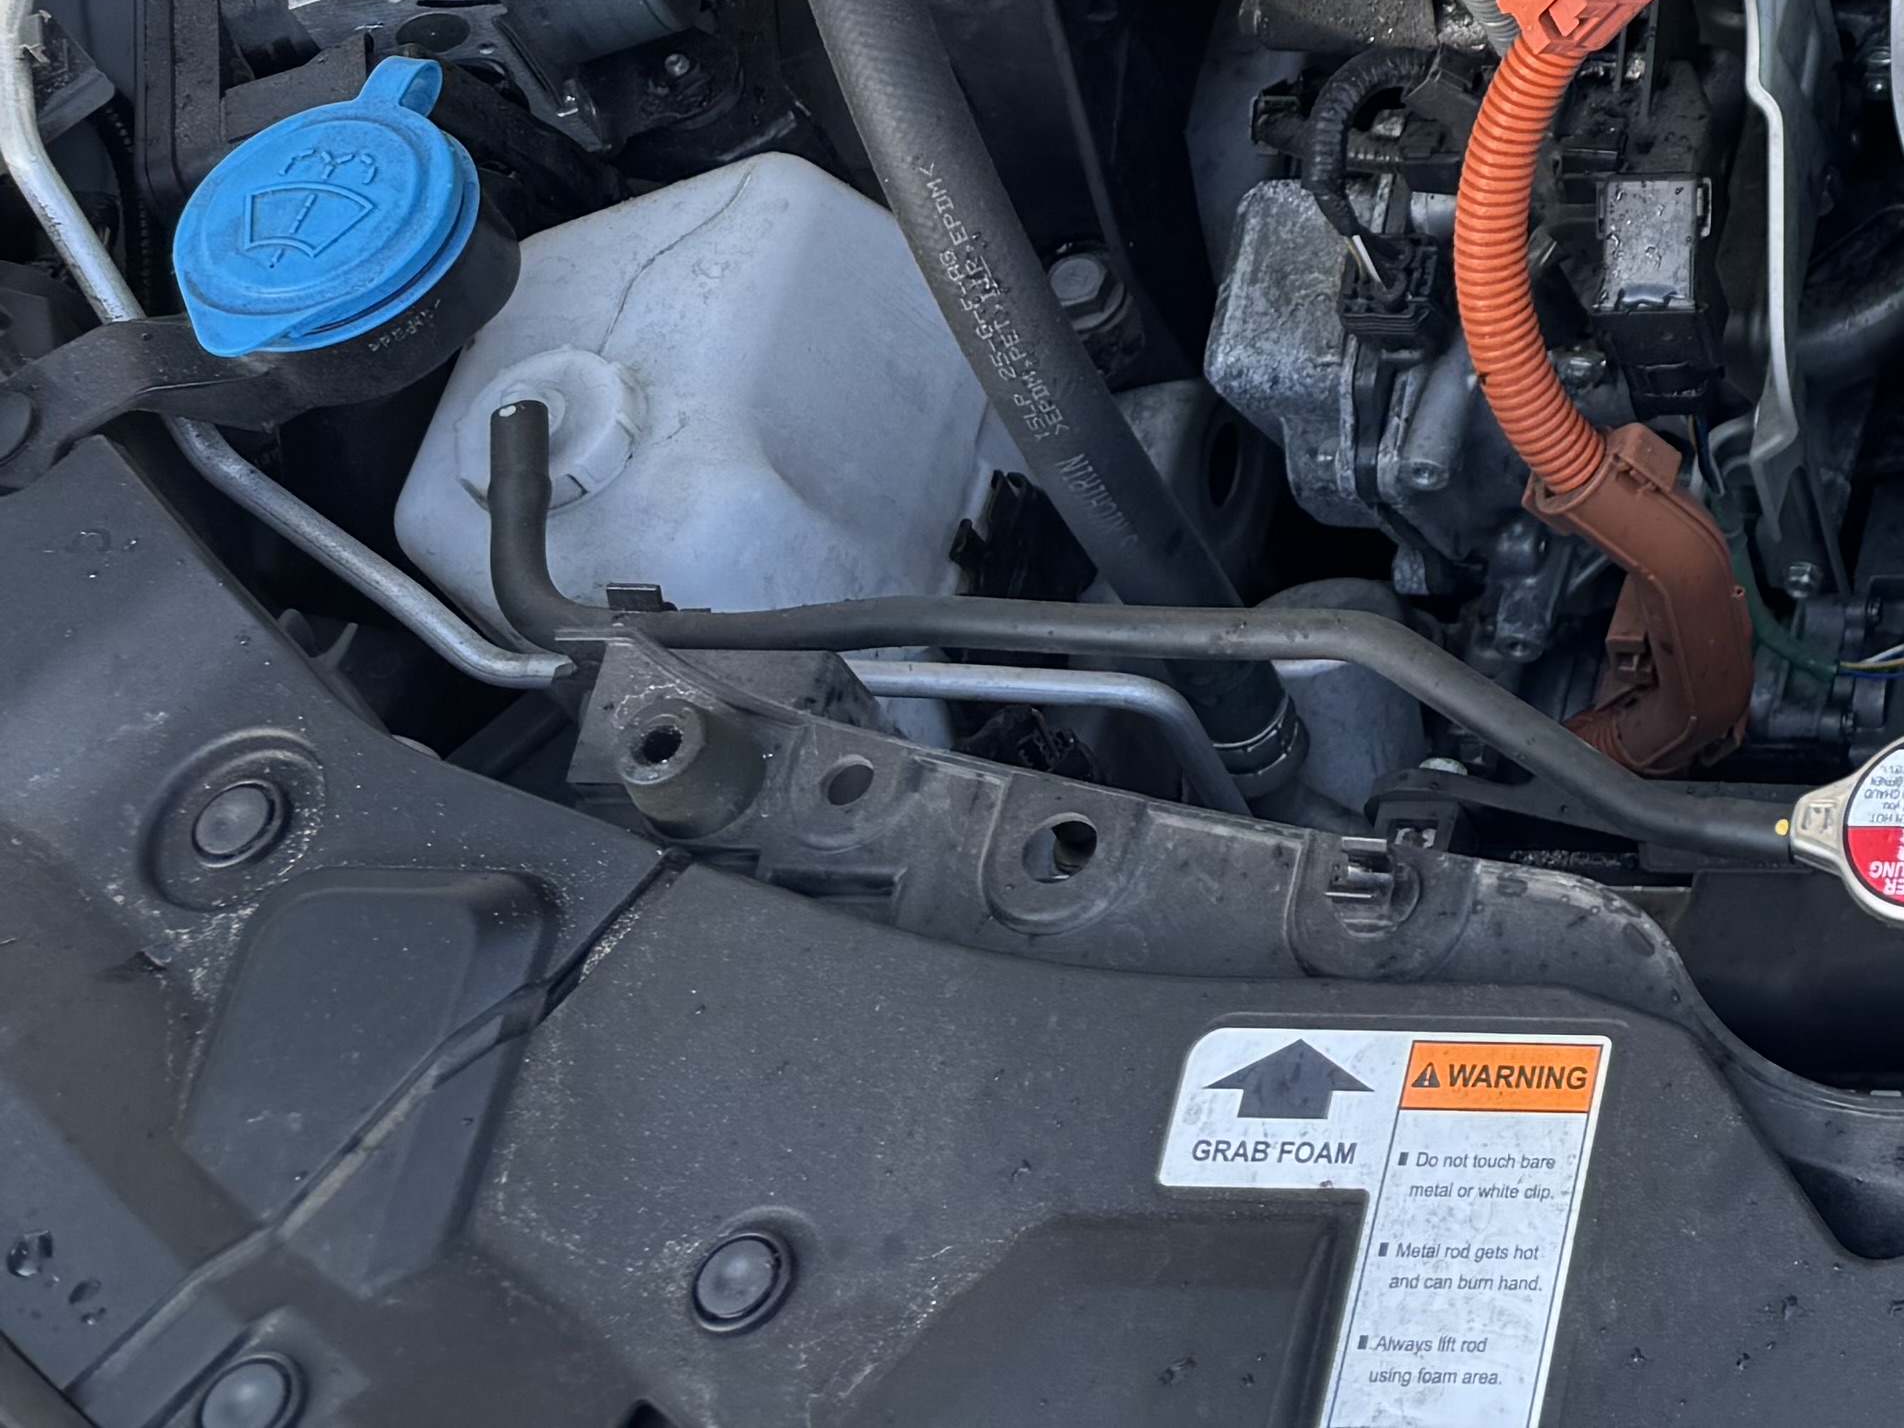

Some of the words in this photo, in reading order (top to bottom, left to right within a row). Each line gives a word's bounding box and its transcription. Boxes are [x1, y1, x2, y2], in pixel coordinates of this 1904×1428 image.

[1448, 1063, 1589, 1090] WARNING
[1192, 1139, 1271, 1162] GRAB
[1276, 1141, 1357, 1164] FOAM
[1416, 1152, 1438, 1169] Do
[1443, 1154, 1468, 1169] not
[1473, 1153, 1516, 1170] touch
[1520, 1154, 1556, 1170] bare
[1409, 1182, 1453, 1199] metal
[1457, 1186, 1473, 1199] or
[1477, 1183, 1519, 1200] white
[1524, 1184, 1555, 1203] clip.
[1395, 1243, 1440, 1260] Metal
[1445, 1243, 1470, 1260] rod
[1474, 1245, 1508, 1263] gets
[1514, 1244, 1539, 1261] hot
[1389, 1275, 1419, 1291] and
[1424, 1278, 1453, 1291] can
[1458, 1275, 1493, 1292] burn
[1498, 1275, 1543, 1292] hand.
[1376, 1335, 1432, 1357] Always
[1437, 1336, 1456, 1353] lift
[1460, 1336, 1488, 1353] rod
[1368, 1368, 1411, 1388] using
[1416, 1367, 1458, 1386] foam
[1462, 1370, 1502, 1386] area.
